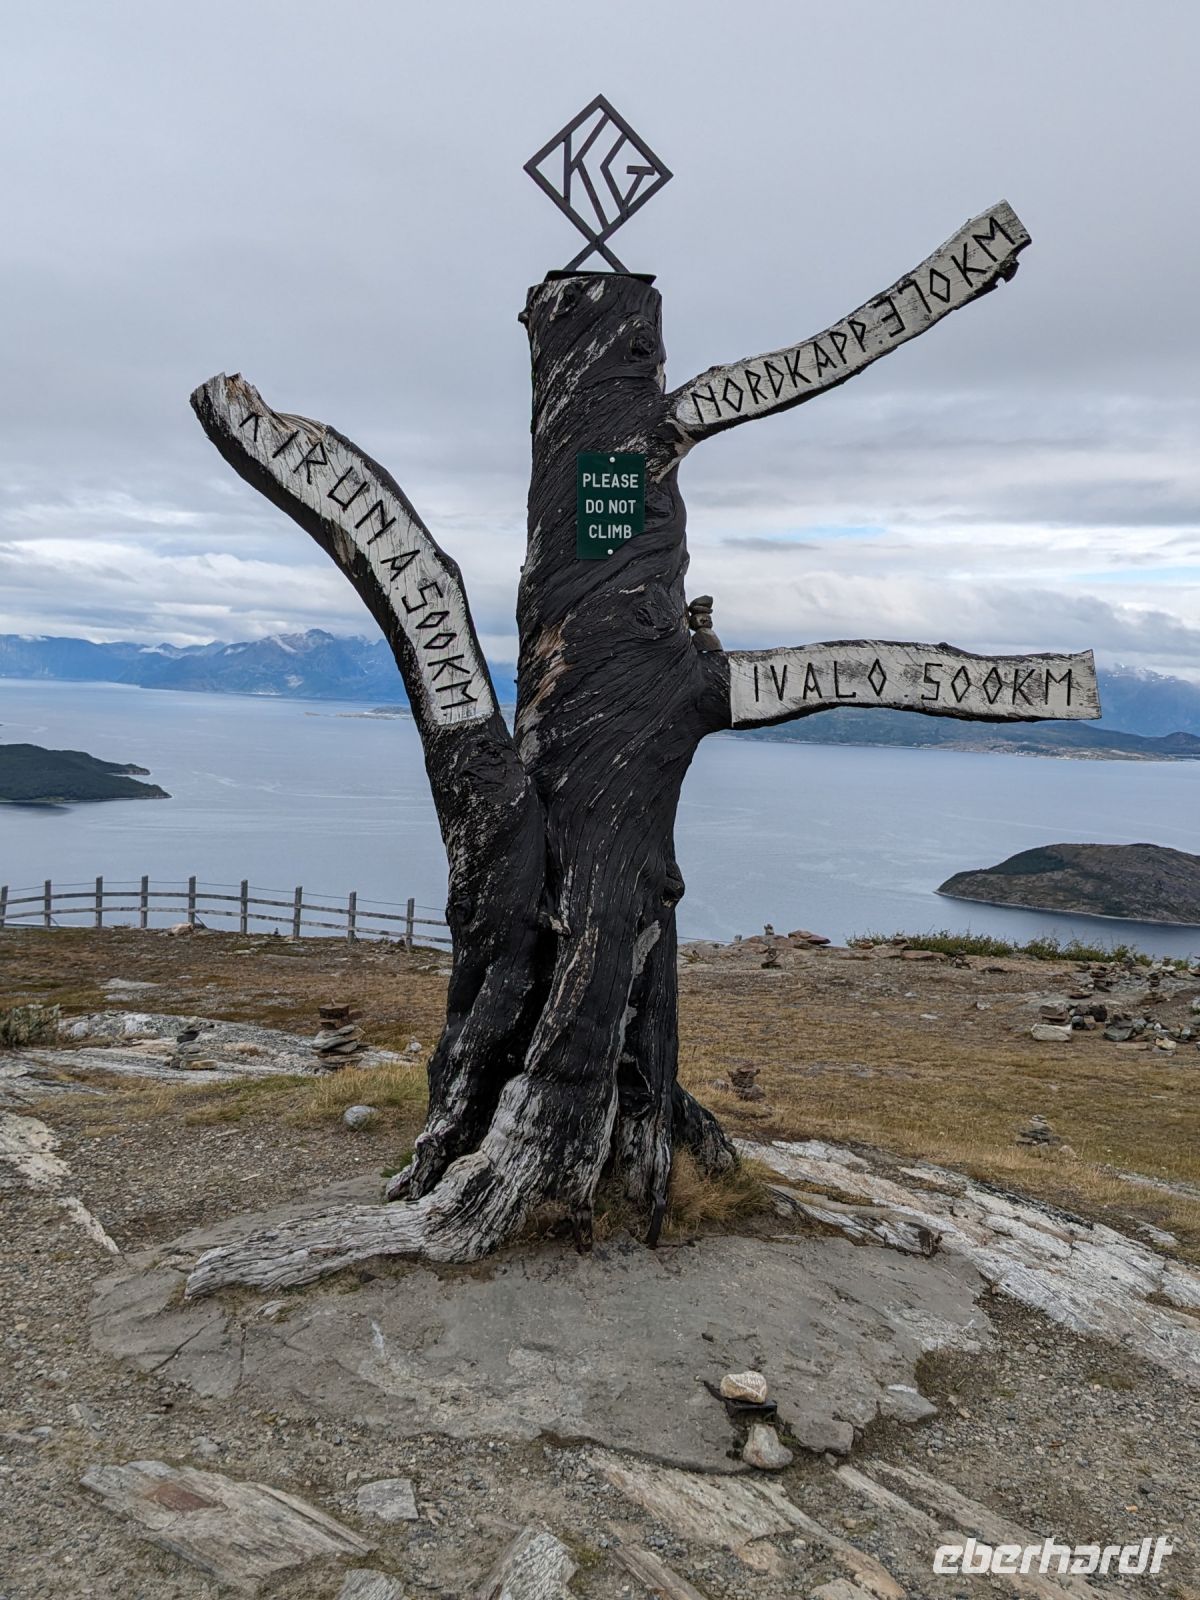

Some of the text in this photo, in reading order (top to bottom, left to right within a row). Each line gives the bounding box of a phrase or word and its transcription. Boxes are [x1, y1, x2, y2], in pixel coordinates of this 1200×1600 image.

[582, 473, 639, 488] PLEASE
[585, 499, 636, 514] DO NOT
[588, 524, 632, 539] CLIMB
